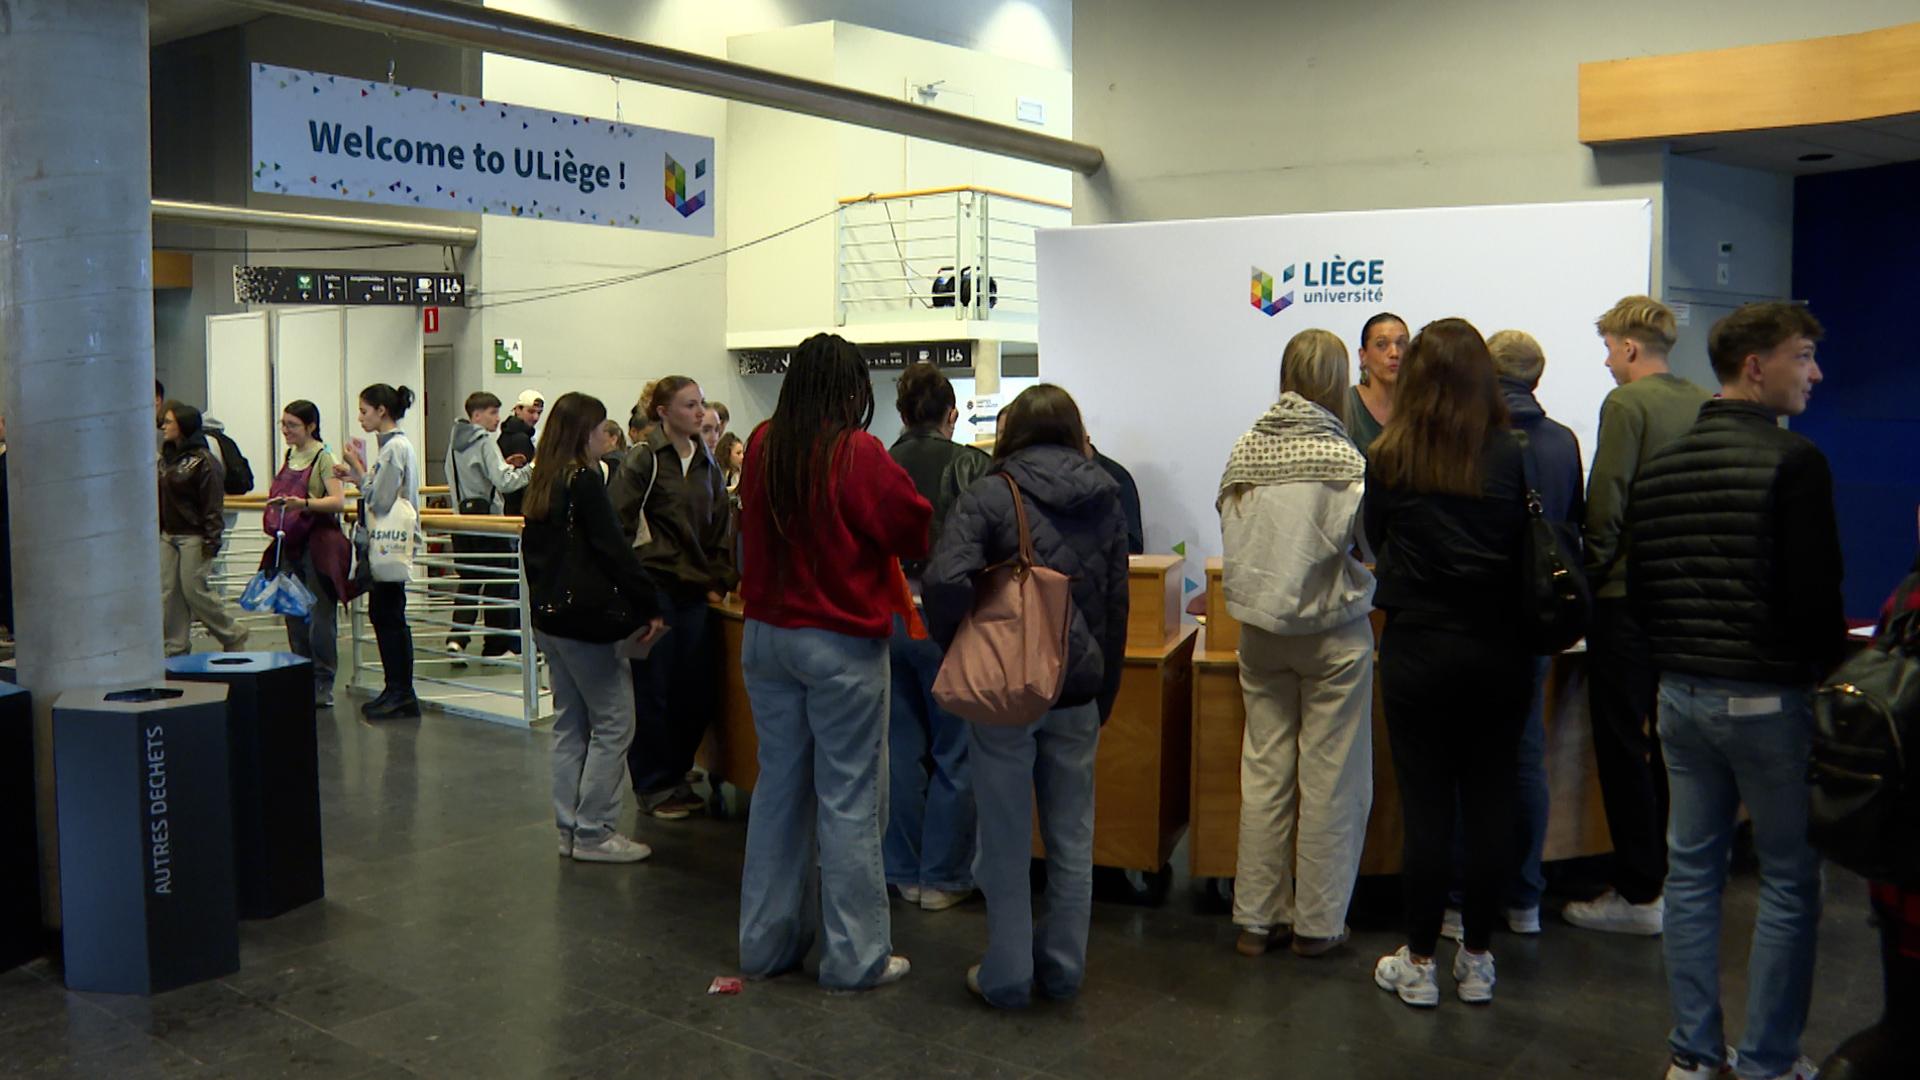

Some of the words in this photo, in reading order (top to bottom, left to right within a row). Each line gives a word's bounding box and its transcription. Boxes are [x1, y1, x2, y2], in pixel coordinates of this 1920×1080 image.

[308, 119, 465, 171] Welcome
[472, 142, 505, 175] to
[513, 147, 611, 194] ULiège
[618, 161, 627, 190] !
[1303, 254, 1385, 287] LIÈGE
[1303, 287, 1385, 303] université
[146, 725, 168, 815] DECHETS
[151, 818, 172, 894] AUTRES
